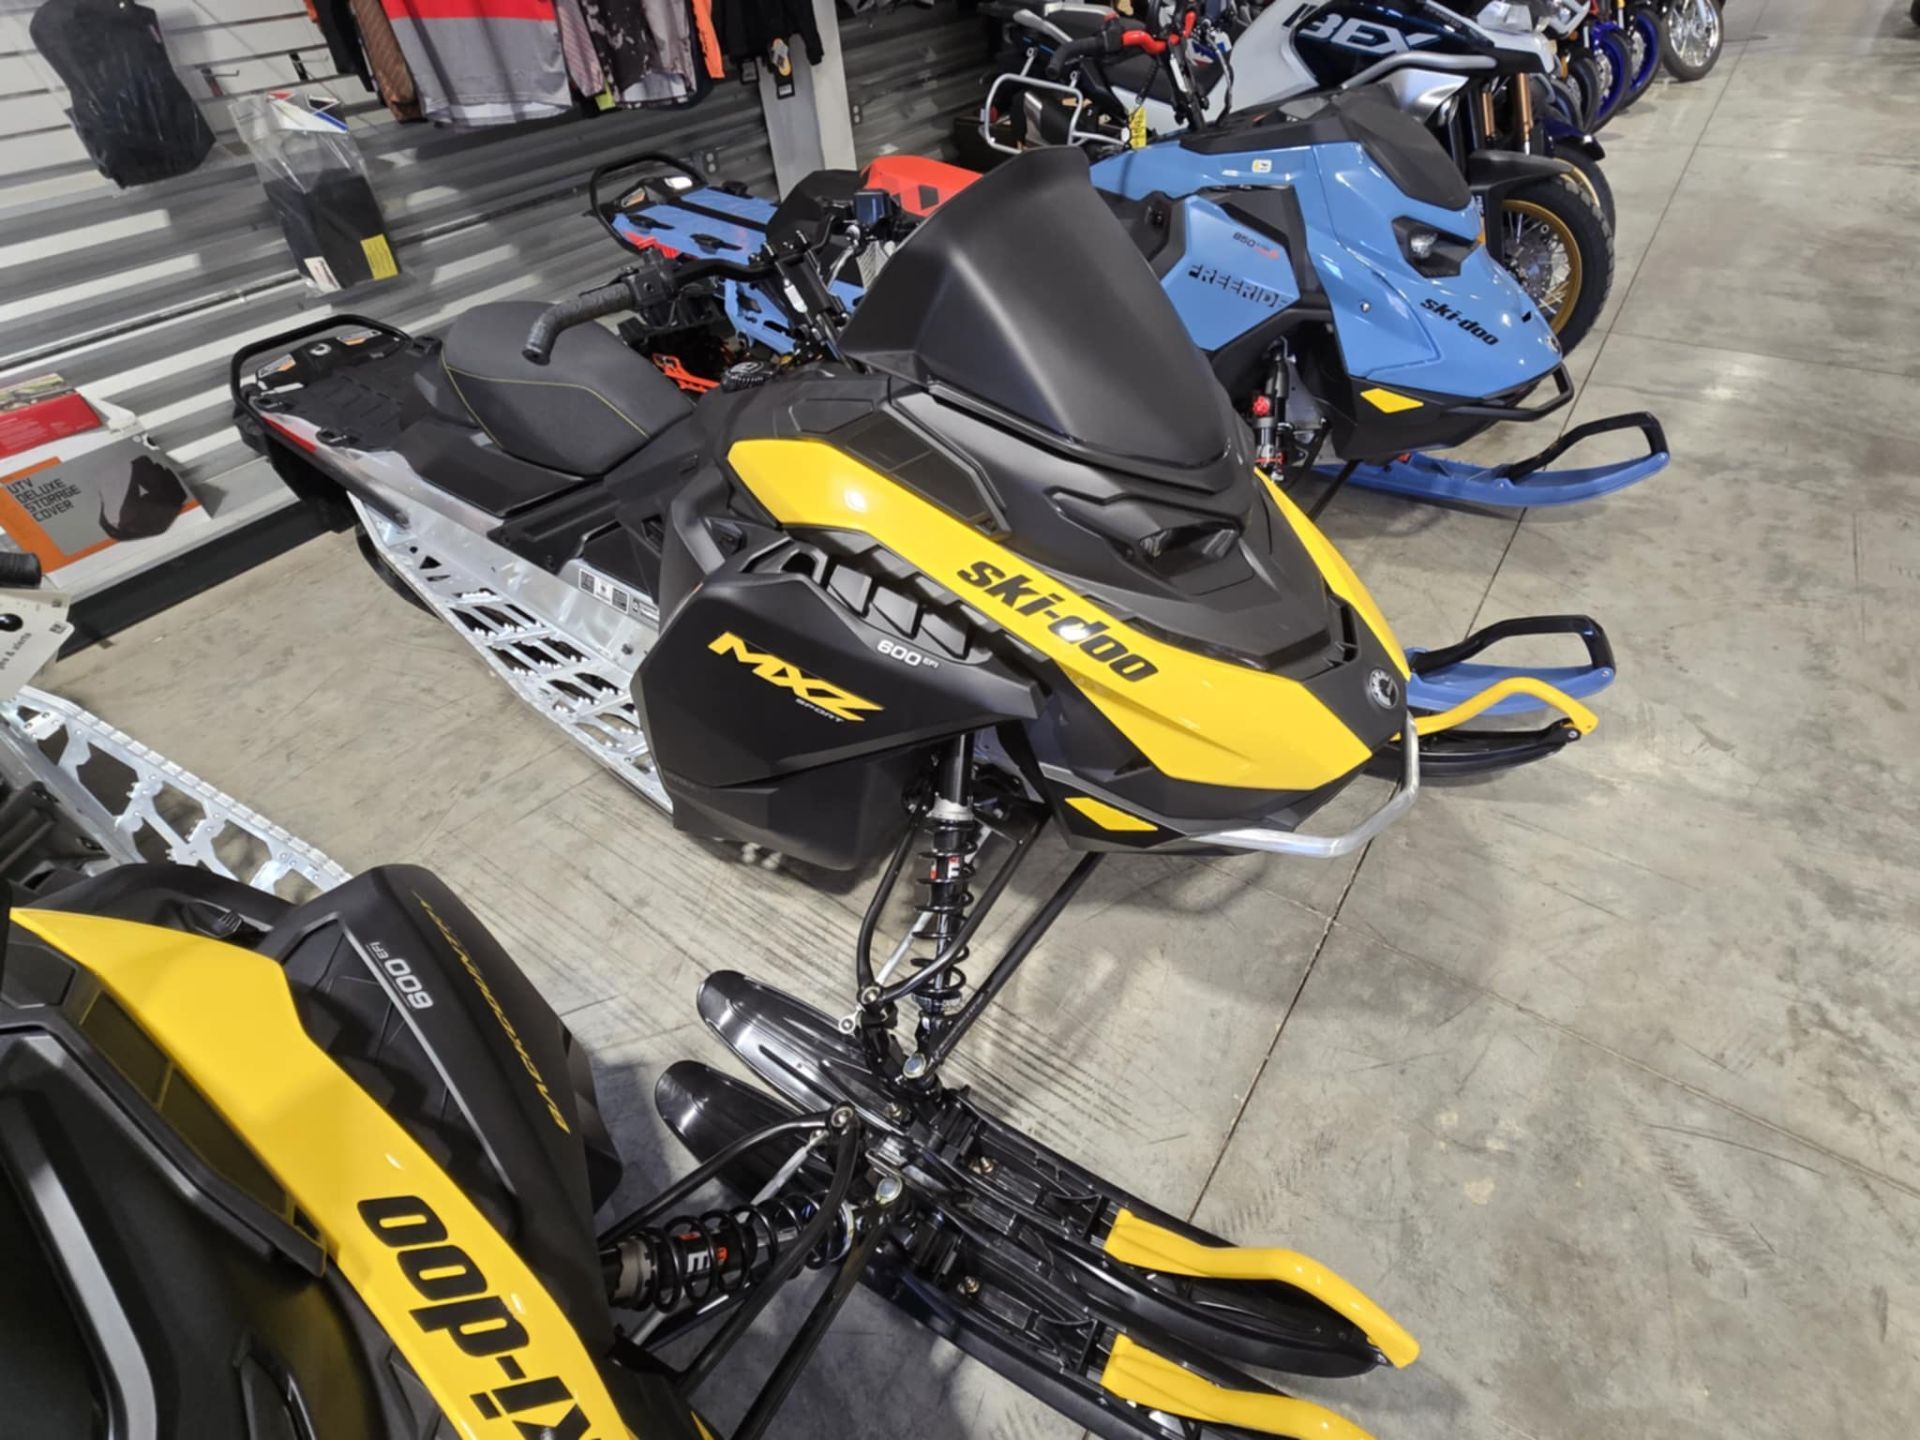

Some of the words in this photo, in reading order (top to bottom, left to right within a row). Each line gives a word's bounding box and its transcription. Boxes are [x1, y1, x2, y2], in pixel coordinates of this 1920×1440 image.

[1420, 298, 1499, 346] ski-doo
[6, 477, 33, 494] UTV
[15, 478, 66, 504] DELUXE
[24, 484, 82, 513] STORAGE
[32, 499, 74, 522] COVER
[956, 560, 1159, 682] ski-doo
[876, 639, 922, 667] 600
[708, 631, 885, 722] MXZ
[795, 698, 844, 724] SPORT
[384, 957, 434, 1010] 600
